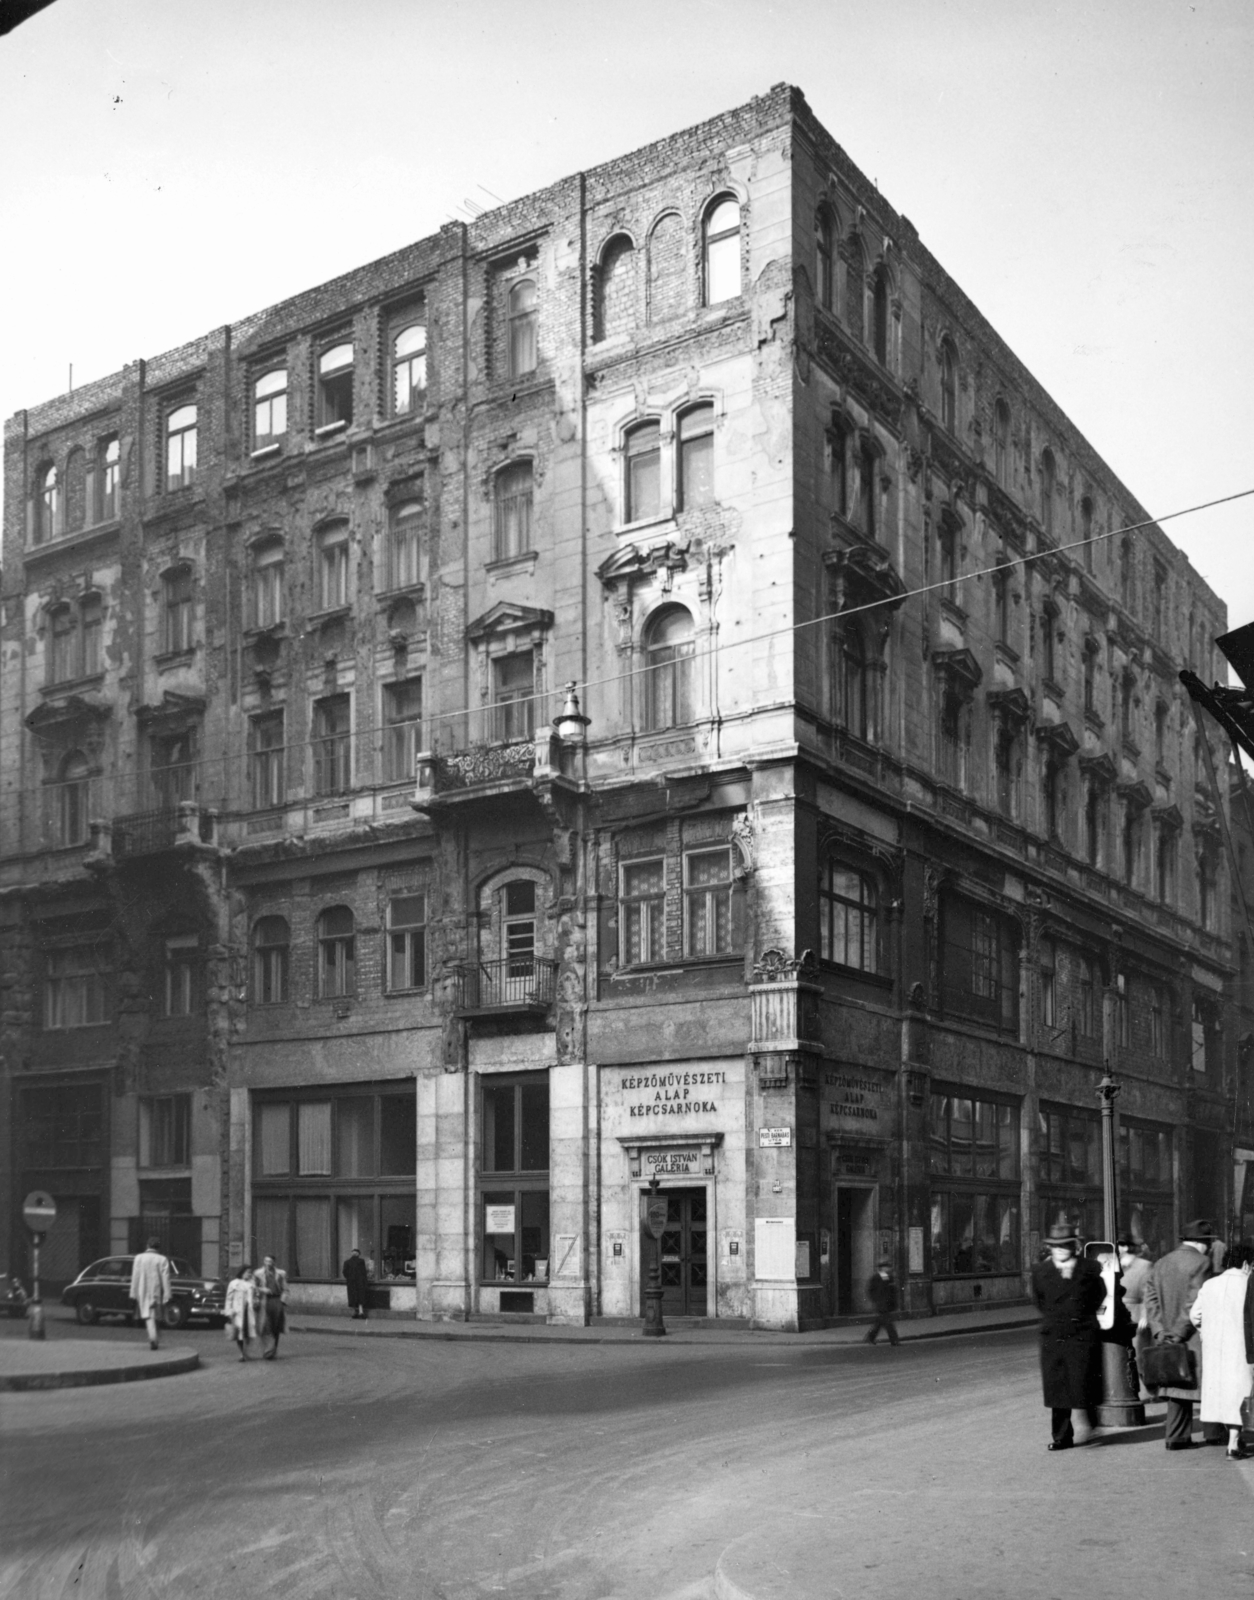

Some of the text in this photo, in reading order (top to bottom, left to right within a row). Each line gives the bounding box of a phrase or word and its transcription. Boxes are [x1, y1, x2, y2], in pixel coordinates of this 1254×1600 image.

[621, 1072, 726, 1089] KÉPZŐMŰVÉSZETI
[654, 1088, 690, 1101] ALAP
[844, 1092, 864, 1104] ALAP
[630, 1101, 717, 1117] KÉPCSARNOKA
[830, 1102, 877, 1119] KÉPCSARNOKA
[647, 1152, 698, 1164] CSÓK ISTVÁN
[654, 1162, 690, 1173] GALÉRIA
